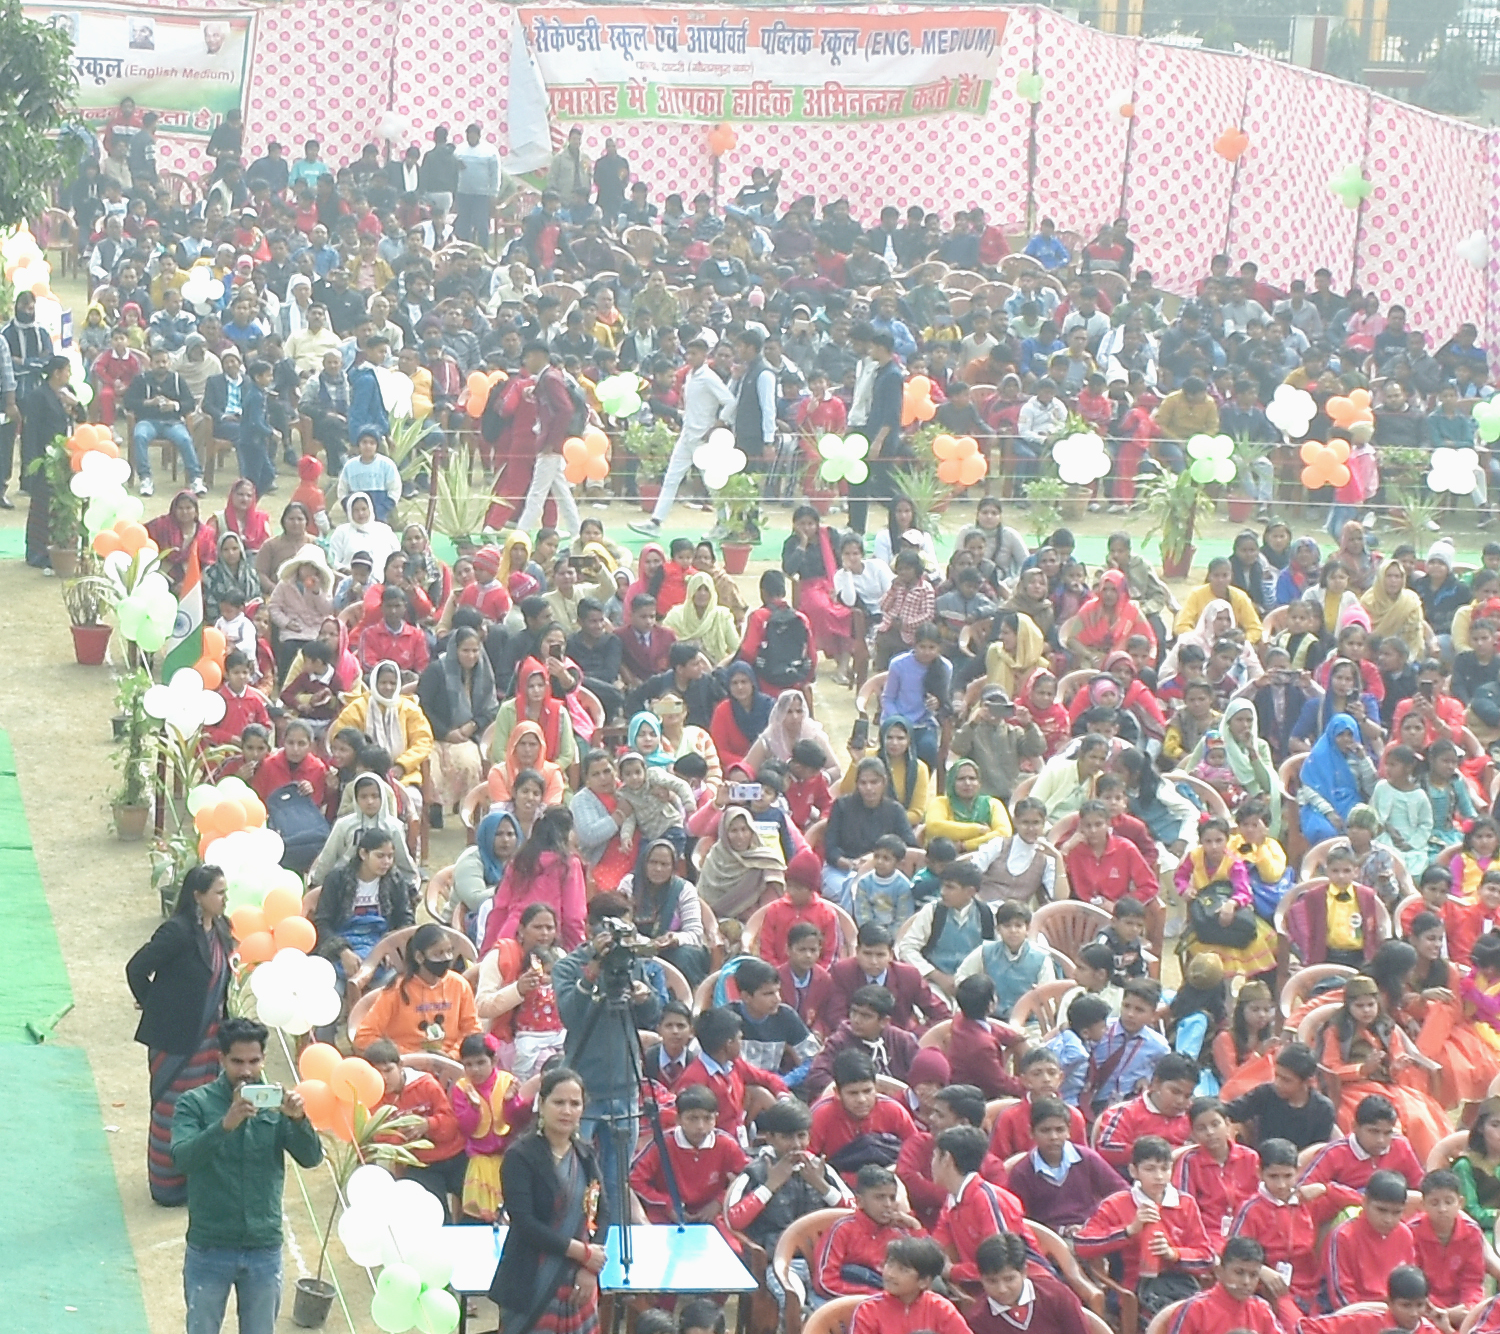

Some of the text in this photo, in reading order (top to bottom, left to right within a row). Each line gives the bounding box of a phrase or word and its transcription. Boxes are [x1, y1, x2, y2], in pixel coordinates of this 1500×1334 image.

[607, 24, 647, 61] स्कूल
[653, 18, 679, 53] एवं
[761, 20, 814, 56] पब्लिक
[820, 28, 860, 66] स्कूल
[865, 29, 915, 62] (ENG.
[921, 27, 997, 58] MEDIUM)
[125, 64, 178, 79] (English
[182, 67, 235, 83] Medium)
[627, 77, 647, 113] में
[657, 85, 725, 116] आपका
[732, 80, 793, 116] हार्दिक
[803, 81, 906, 116] अभिनन्दन
[911, 75, 952, 110] करते
